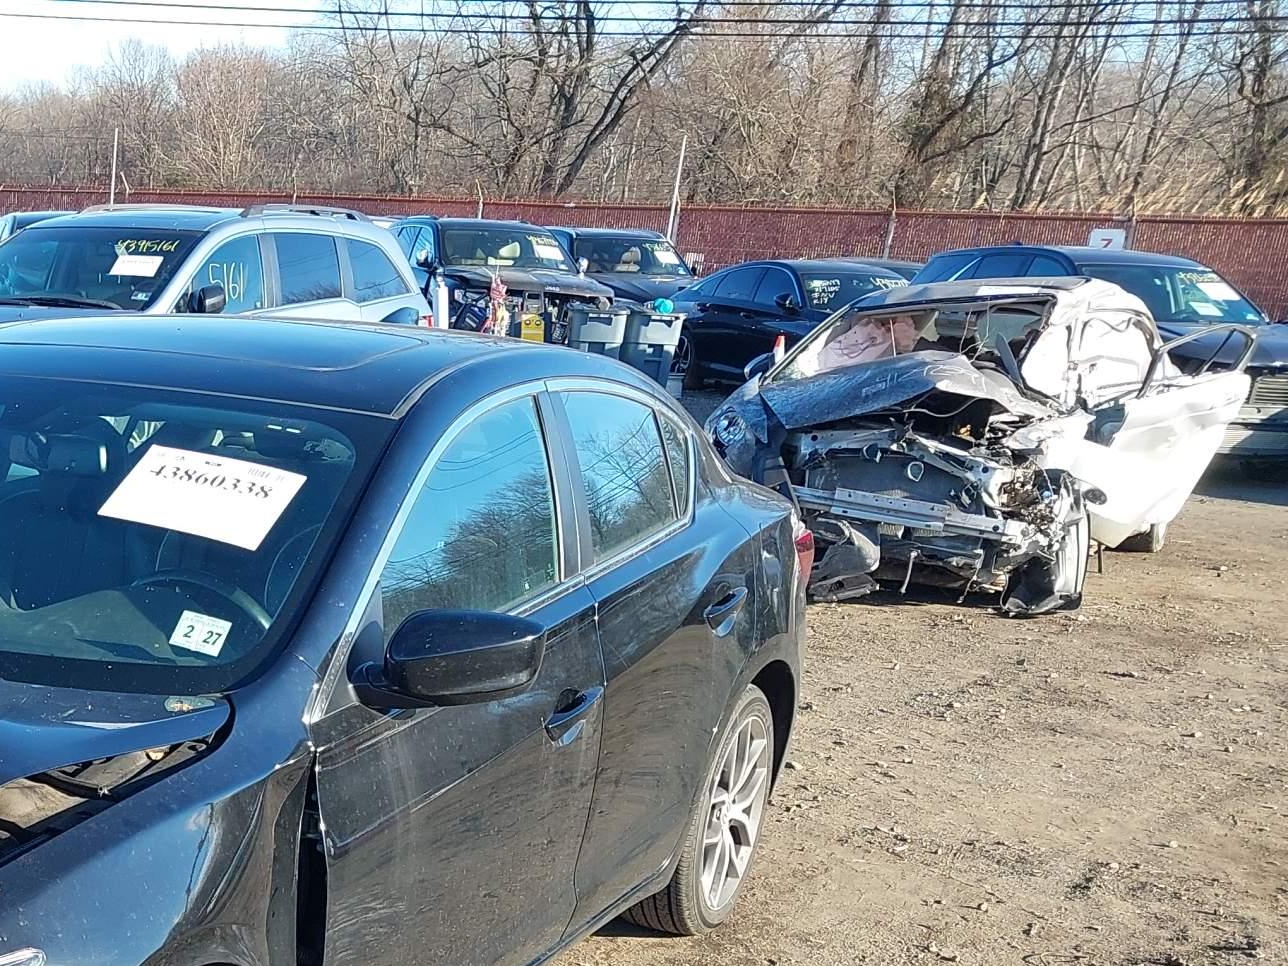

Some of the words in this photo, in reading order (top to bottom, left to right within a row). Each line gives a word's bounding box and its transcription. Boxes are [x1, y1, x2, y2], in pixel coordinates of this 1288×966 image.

[116, 239, 181, 252] 43915161
[209, 262, 244, 303] 5161
[150, 464, 272, 499] 43860338
[183, 625, 195, 638] 2
[202, 630, 223, 646] 27
